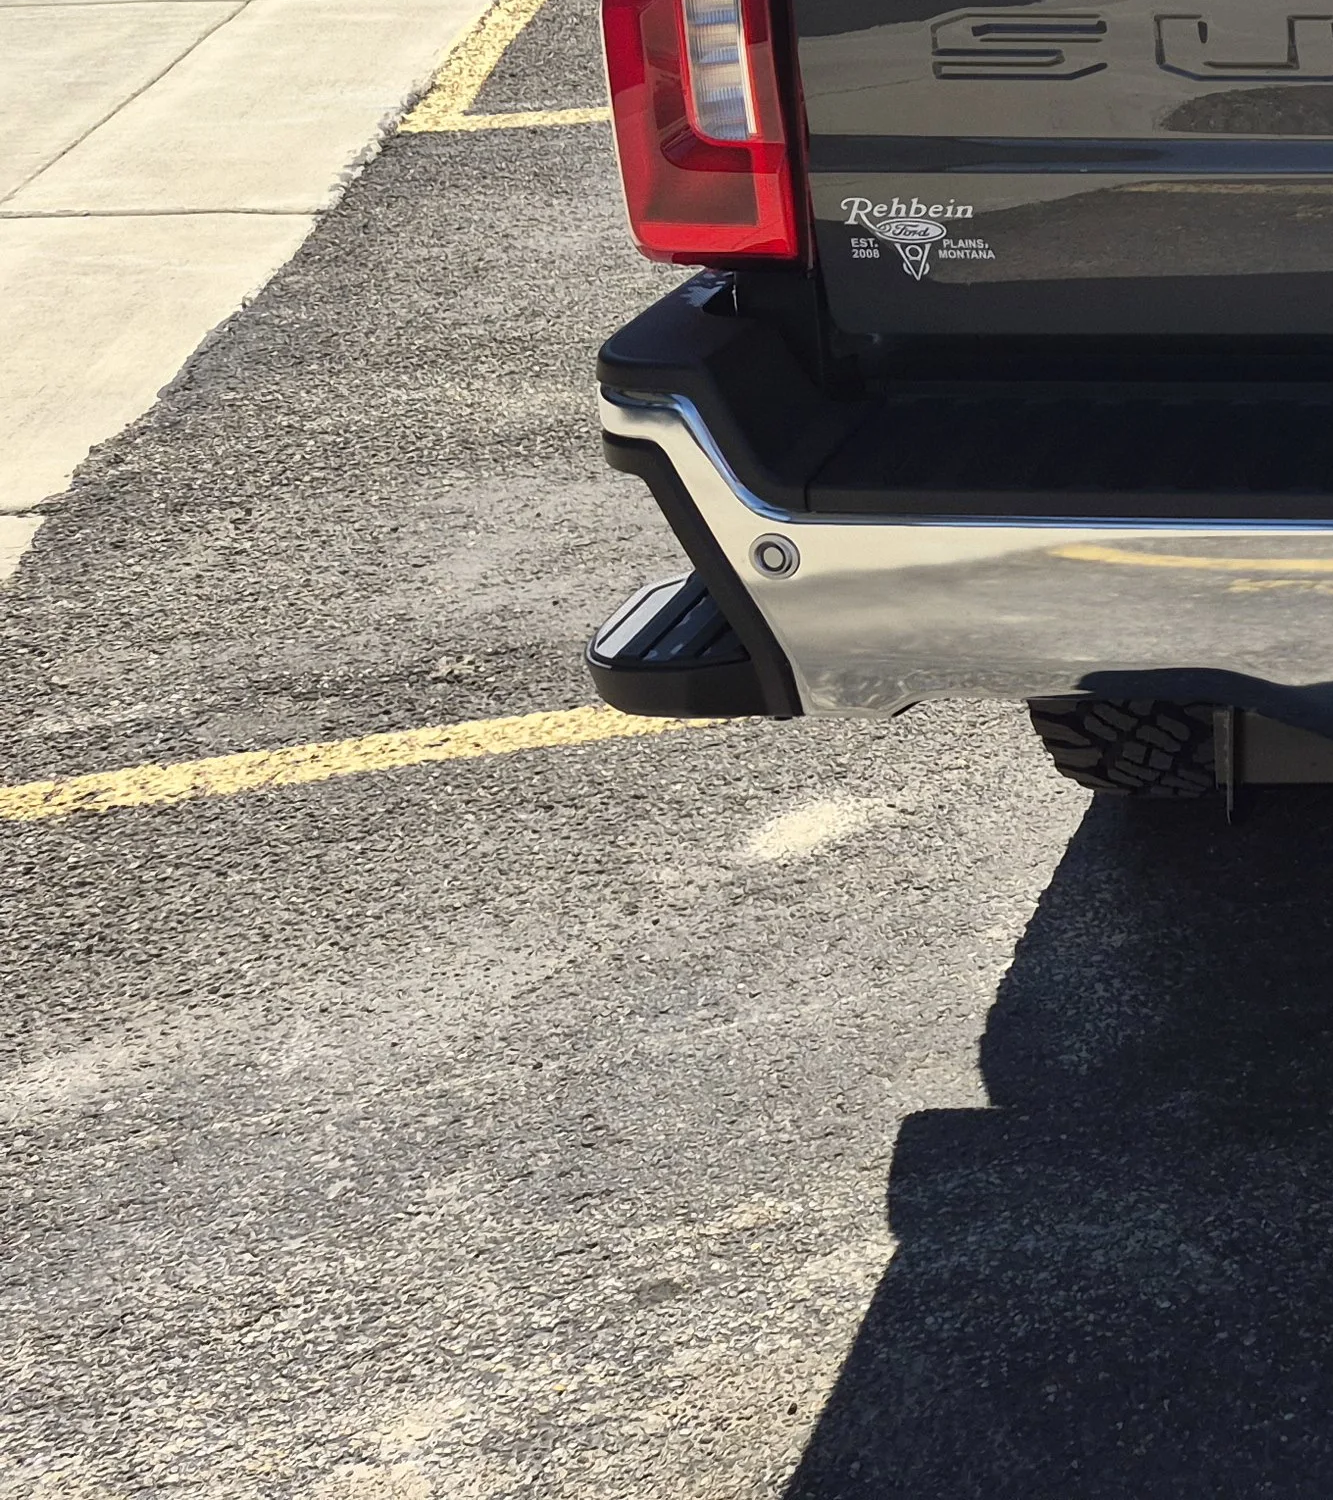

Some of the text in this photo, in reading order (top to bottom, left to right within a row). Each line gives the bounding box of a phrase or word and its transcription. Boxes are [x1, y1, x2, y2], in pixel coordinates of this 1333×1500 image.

[840, 197, 974, 233] Rehbein
[850, 238, 879, 249] EST.
[851, 249, 881, 260] 2008
[938, 249, 996, 260] MONTANA
